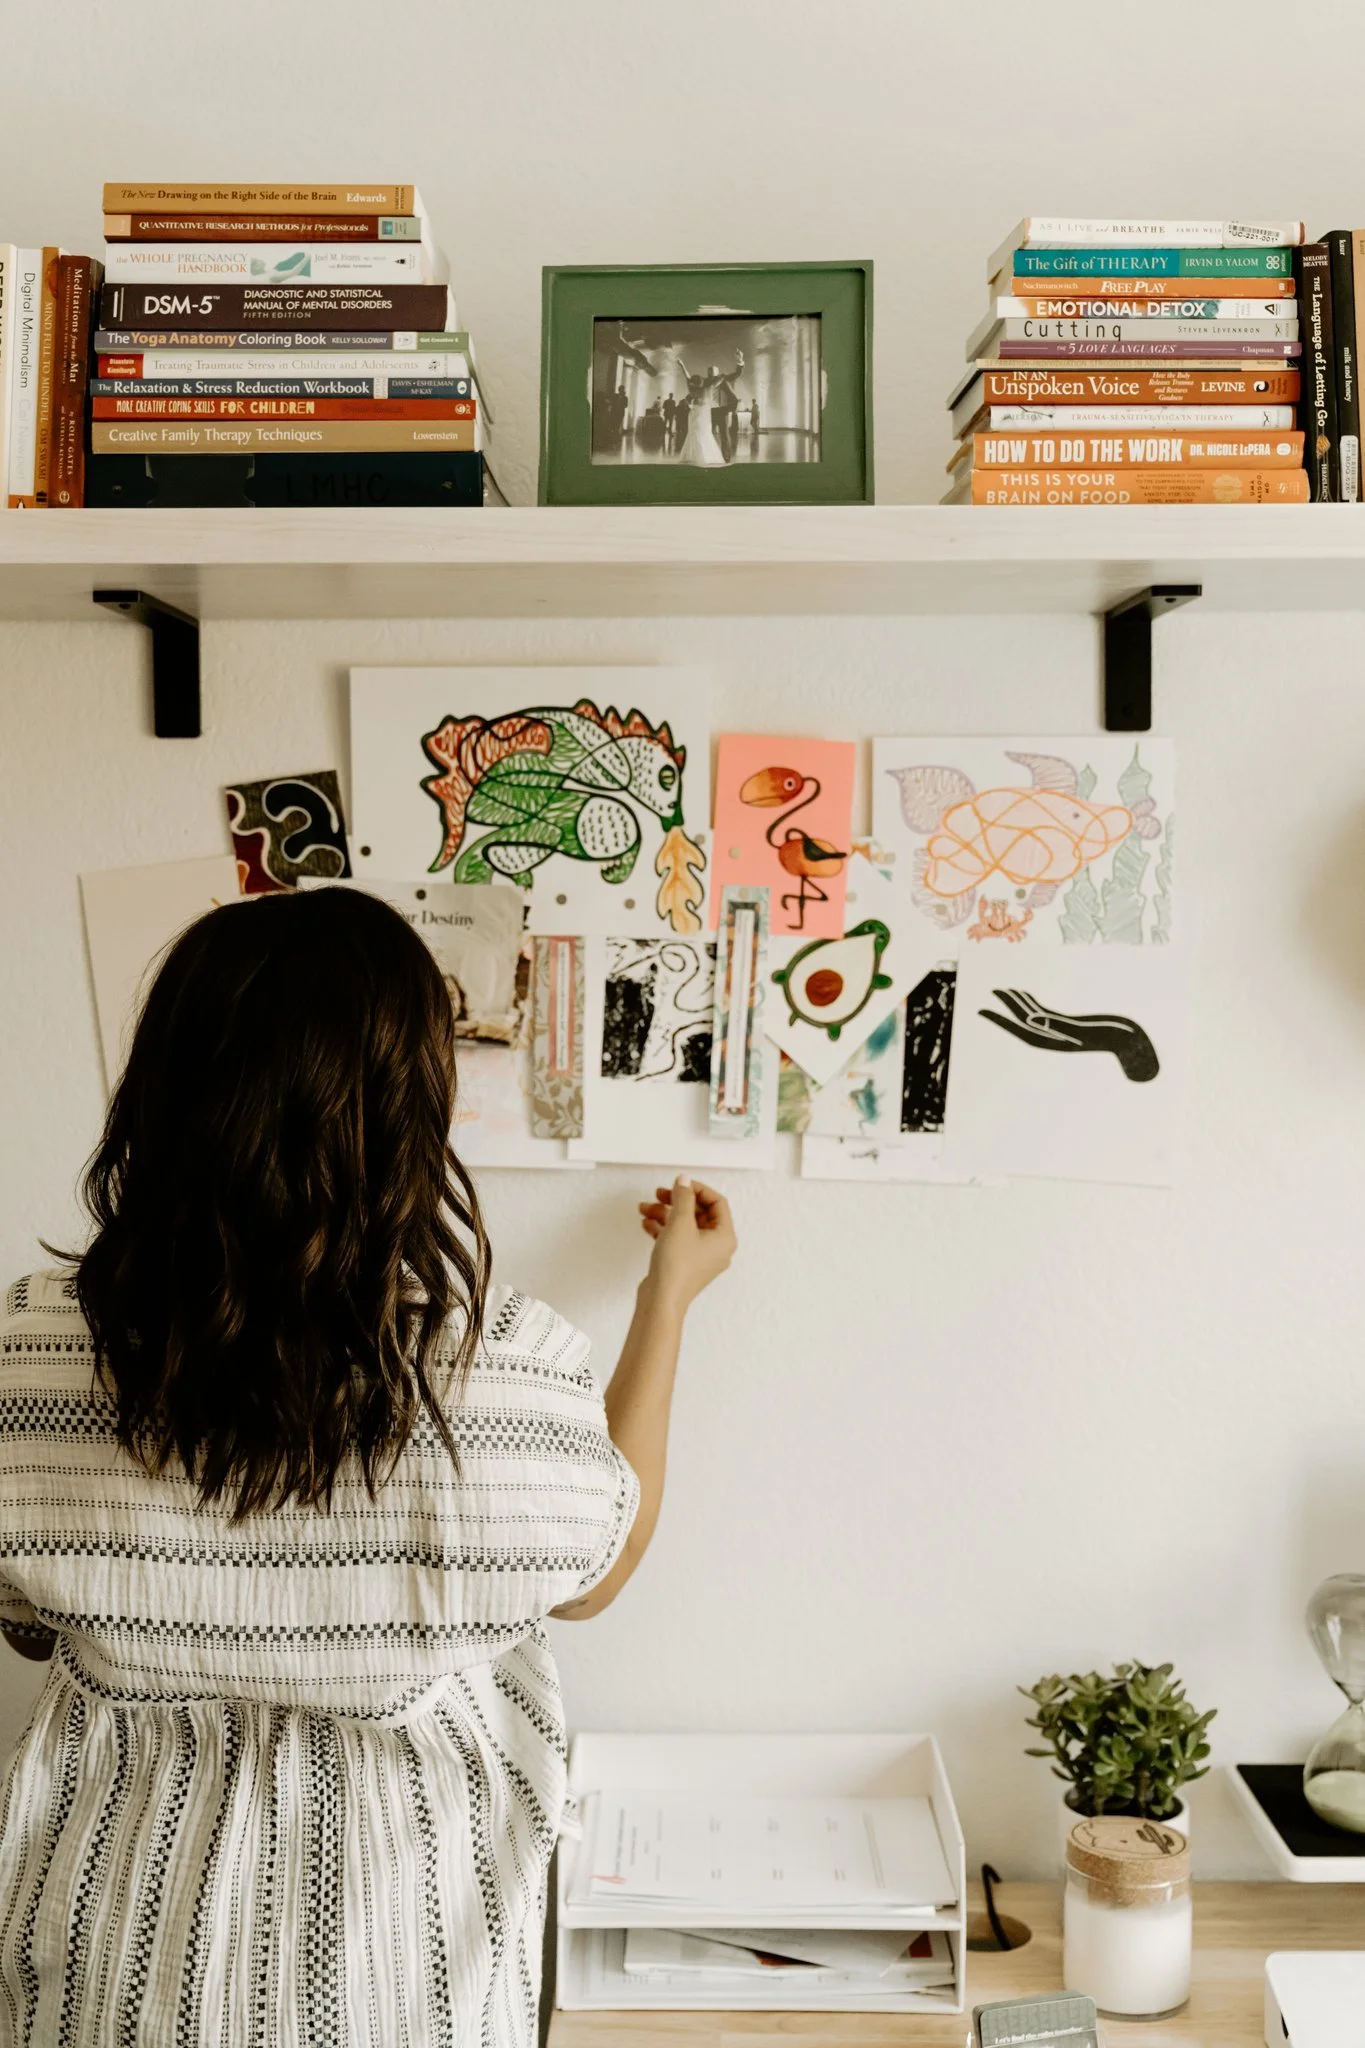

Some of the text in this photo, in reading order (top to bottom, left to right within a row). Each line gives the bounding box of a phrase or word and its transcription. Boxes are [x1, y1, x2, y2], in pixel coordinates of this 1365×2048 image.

[157, 190, 198, 201] Drawing
[200, 192, 210, 200] on
[214, 190, 229, 200] the
[231, 190, 257, 202] Right
[260, 192, 280, 200] Side
[282, 192, 293, 200] of
[294, 192, 310, 200] the
[311, 192, 337, 201] Brain
[346, 193, 387, 203] Edwards
[139, 222, 204, 230] QUANTITATIVE
[205, 222, 254, 230] RESEARCH
[300, 223, 312, 232] for
[314, 224, 369, 232] Professionals
[116, 252, 248, 264] the WHOLE PREGNANCY
[1025, 256, 1168, 270] The Gift of THERAPY
[1185, 258, 1258, 267] IRVIN D. YALOM
[177, 264, 248, 273] HANDBOOK
[244, 289, 383, 299] DIAGNOSTIC AND STATISTICAL
[1100, 280, 1167, 294] FREE PLAY
[244, 300, 392, 310] MANUAL OF MENTAL DISORDERS
[1036, 301, 1206, 317] EMOTIONAL DETOX
[70, 268, 84, 384] Meditations from the Mat
[1311, 293, 1323, 350] Language
[20, 272, 36, 388] Digital Minimalism
[108, 332, 327, 348] The Yoga Anatomy Coloring Book
[1068, 343, 1076, 354] 5
[1078, 344, 1109, 353] LOVE
[1242, 346, 1275, 355] Chapman
[1344, 347, 1352, 364] milk
[40, 302, 53, 422] MIND FULL TO MINDFUL
[1315, 353, 1326, 364] of
[154, 360, 420, 374] Treating Traumatic Stress in Children and Adolescents
[1013, 372, 1048, 381] IN AN
[98, 384, 112, 392] The
[114, 381, 179, 394] Relaxation
[182, 384, 193, 394] &
[195, 380, 232, 394] Stress
[236, 381, 300, 394] Reduction
[303, 380, 370, 394] Workbook
[990, 376, 1139, 400] Unspoken Voice
[1201, 382, 1246, 393] LEVINE
[1314, 365, 1326, 408] Letting
[1344, 380, 1352, 402] honey
[116, 400, 315, 414] MORE CREATIVE COPING SKILLS FOR CHILDREN
[1317, 409, 1328, 426] Go
[108, 428, 323, 445] Creative Family Therapy Techniques
[413, 431, 458, 440] Lowenstein
[984, 438, 1183, 464] HOW TO DO THE WORK
[1190, 444, 1204, 456] DR.
[1207, 444, 1238, 456] NICOLE
[38, 448, 48, 480] SWAMI
[1000, 473, 1115, 486] THIS IS YOUR
[986, 490, 1130, 504] BRAIN ON FOOD
[422, 910, 476, 930] Destiny
